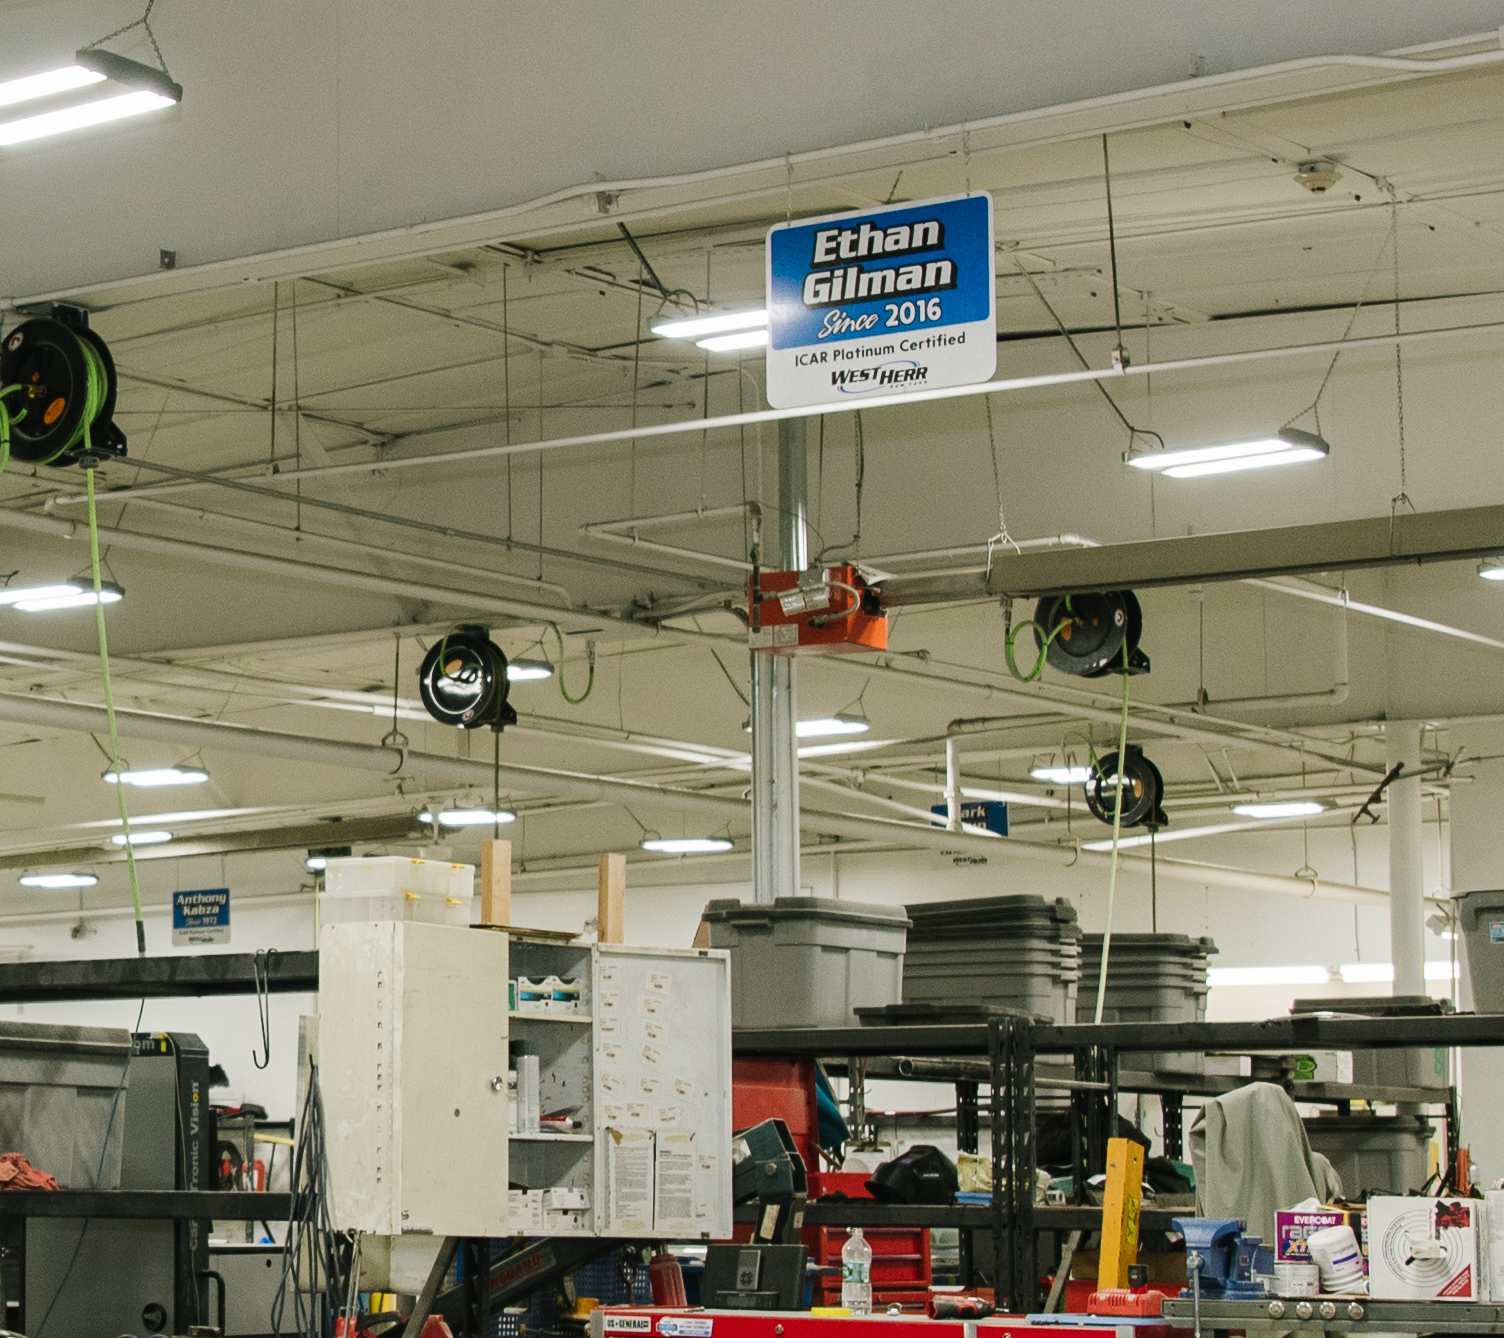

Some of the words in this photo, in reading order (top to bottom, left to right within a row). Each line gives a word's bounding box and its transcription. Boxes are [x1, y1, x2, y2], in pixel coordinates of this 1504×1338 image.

[813, 220, 940, 264] Ethan
[802, 260, 952, 306] Gilman
[817, 308, 879, 339] Since
[884, 297, 942, 327] 2016
[795, 351, 828, 367] ICAR
[833, 343, 895, 362] Platinum
[899, 331, 967, 352] Certified
[176, 893, 227, 905] Anthony
[183, 905, 220, 916] Kabza
[190, 1081, 200, 1135] Vision
[1294, 1216, 1337, 1224] EVERCOAT
